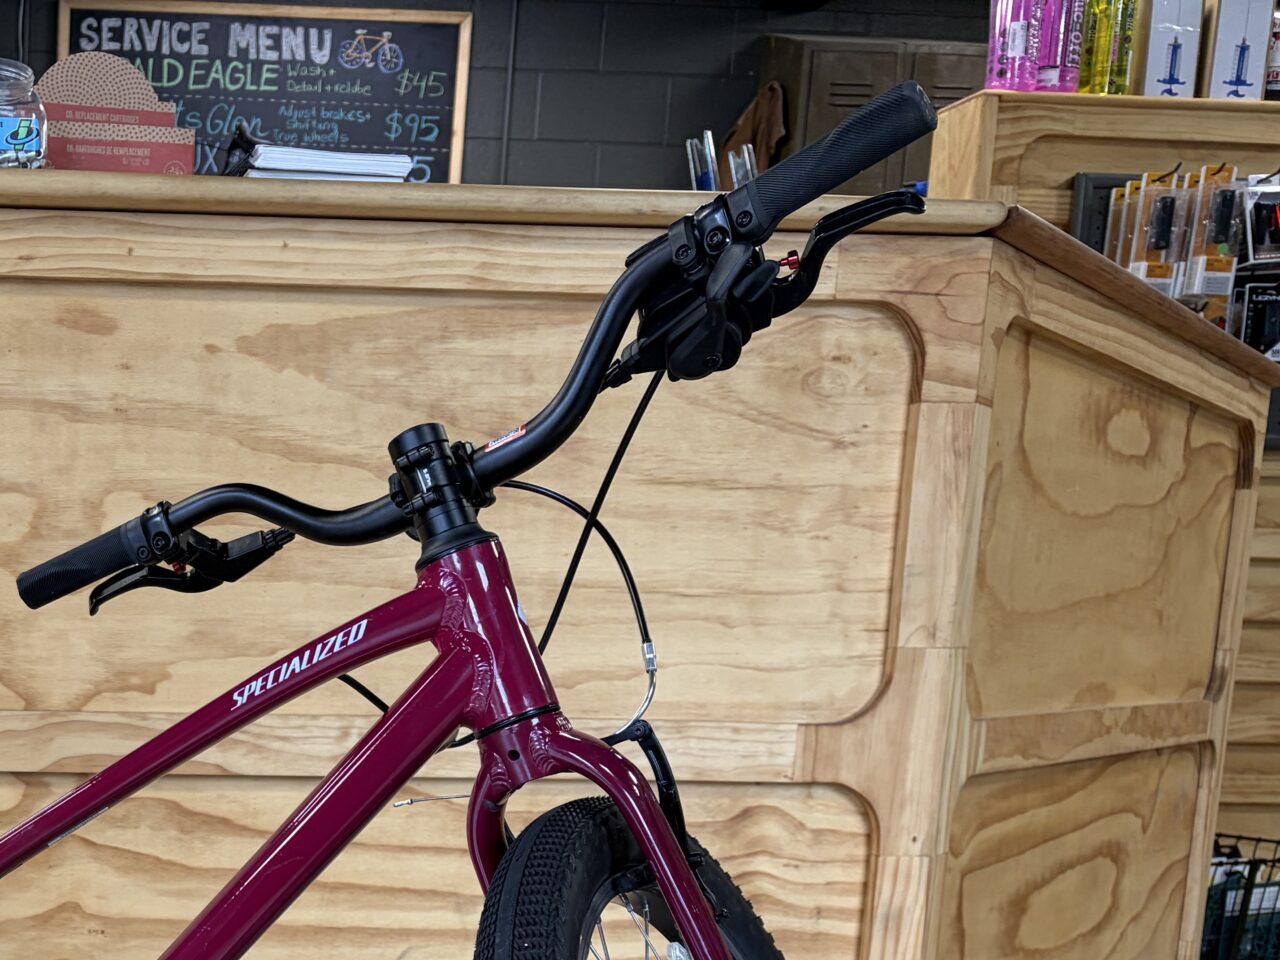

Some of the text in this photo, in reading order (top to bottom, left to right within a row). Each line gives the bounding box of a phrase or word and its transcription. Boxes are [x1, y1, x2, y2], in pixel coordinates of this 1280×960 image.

[79, 17, 332, 65] SERVICE MENU
[1068, 0, 1085, 63] uc-Off
[134, 57, 280, 92] ALD EAGLE
[286, 79, 322, 93] Detail
[287, 63, 326, 77] Wash
[394, 68, 448, 99] $45
[279, 105, 317, 120] Adjust
[384, 109, 441, 143] $95
[231, 619, 368, 711] SPECIALIZED
